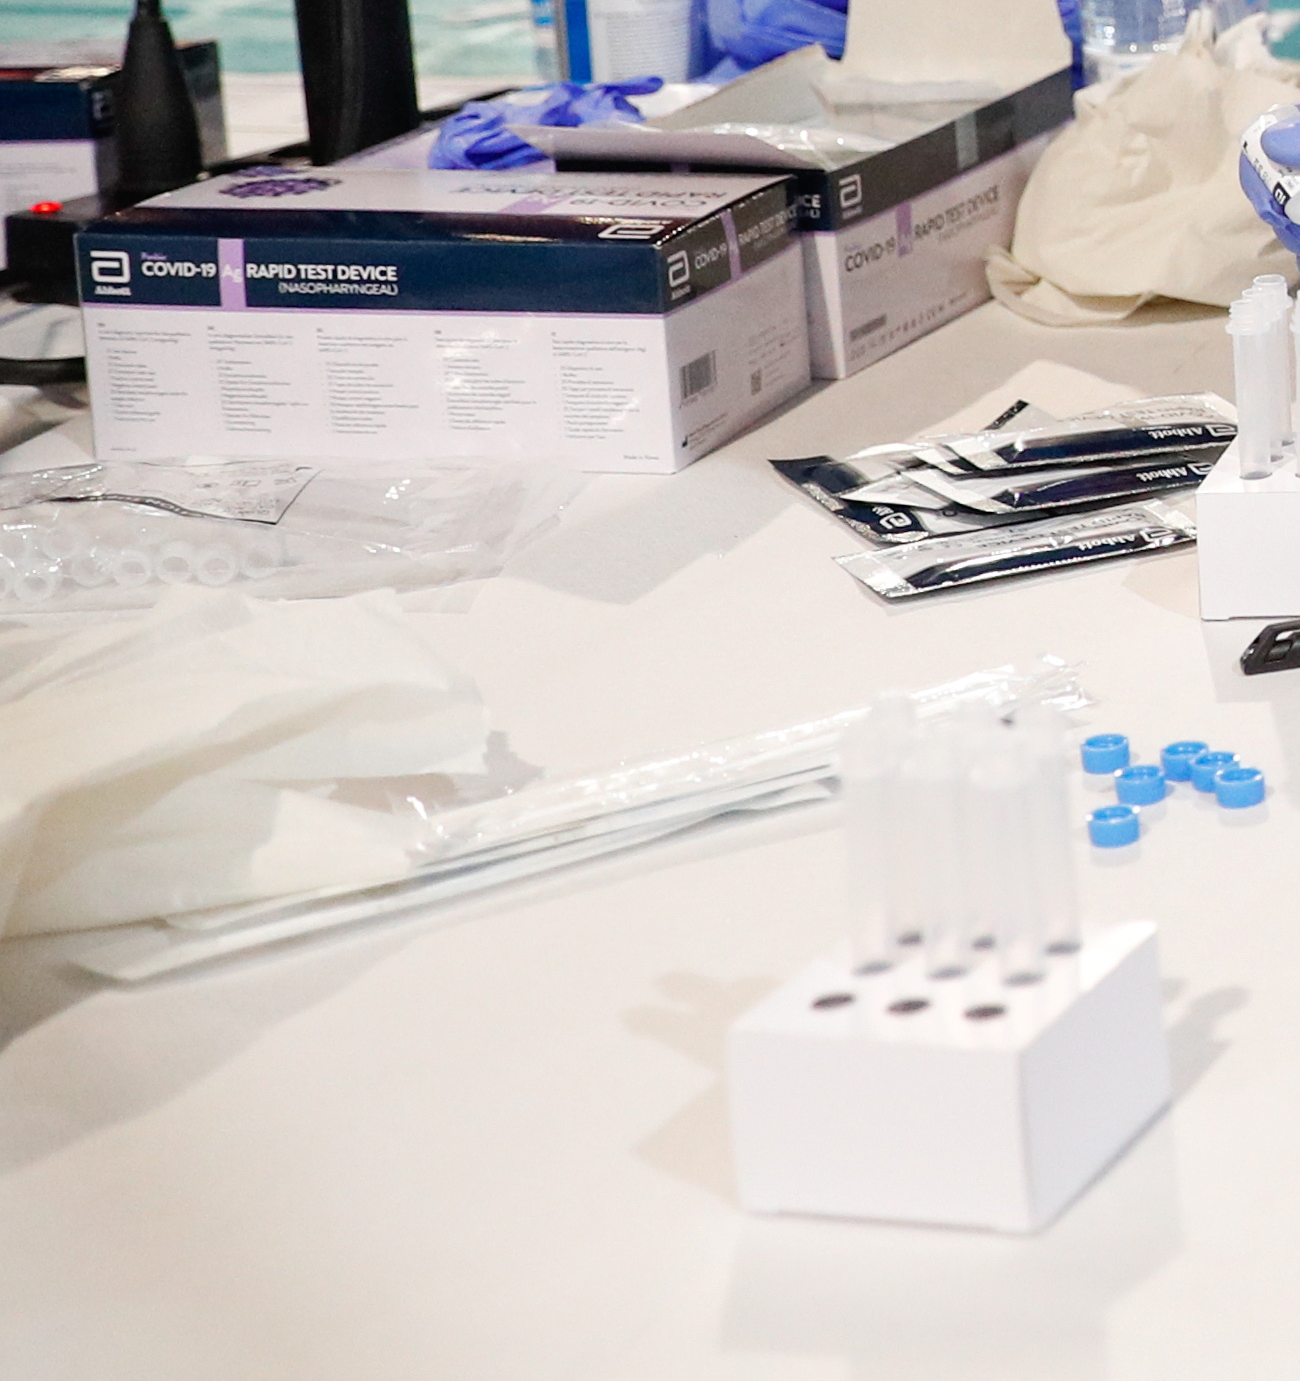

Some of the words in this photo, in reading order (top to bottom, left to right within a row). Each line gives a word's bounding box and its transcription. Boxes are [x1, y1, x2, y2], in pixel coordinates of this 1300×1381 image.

[844, 236, 896, 273] COVID-19
[141, 261, 217, 278] COVID-19
[221, 263, 243, 284] Ag
[246, 263, 294, 280] RAPID
[297, 264, 334, 281] TEST
[340, 265, 398, 282] DEVICE
[278, 282, 398, 296] (NASOPHARYNGEAL)
[1148, 426, 1203, 440] Abbott
[1136, 466, 1188, 483] Abbott
[1073, 533, 1136, 552] Abbott
